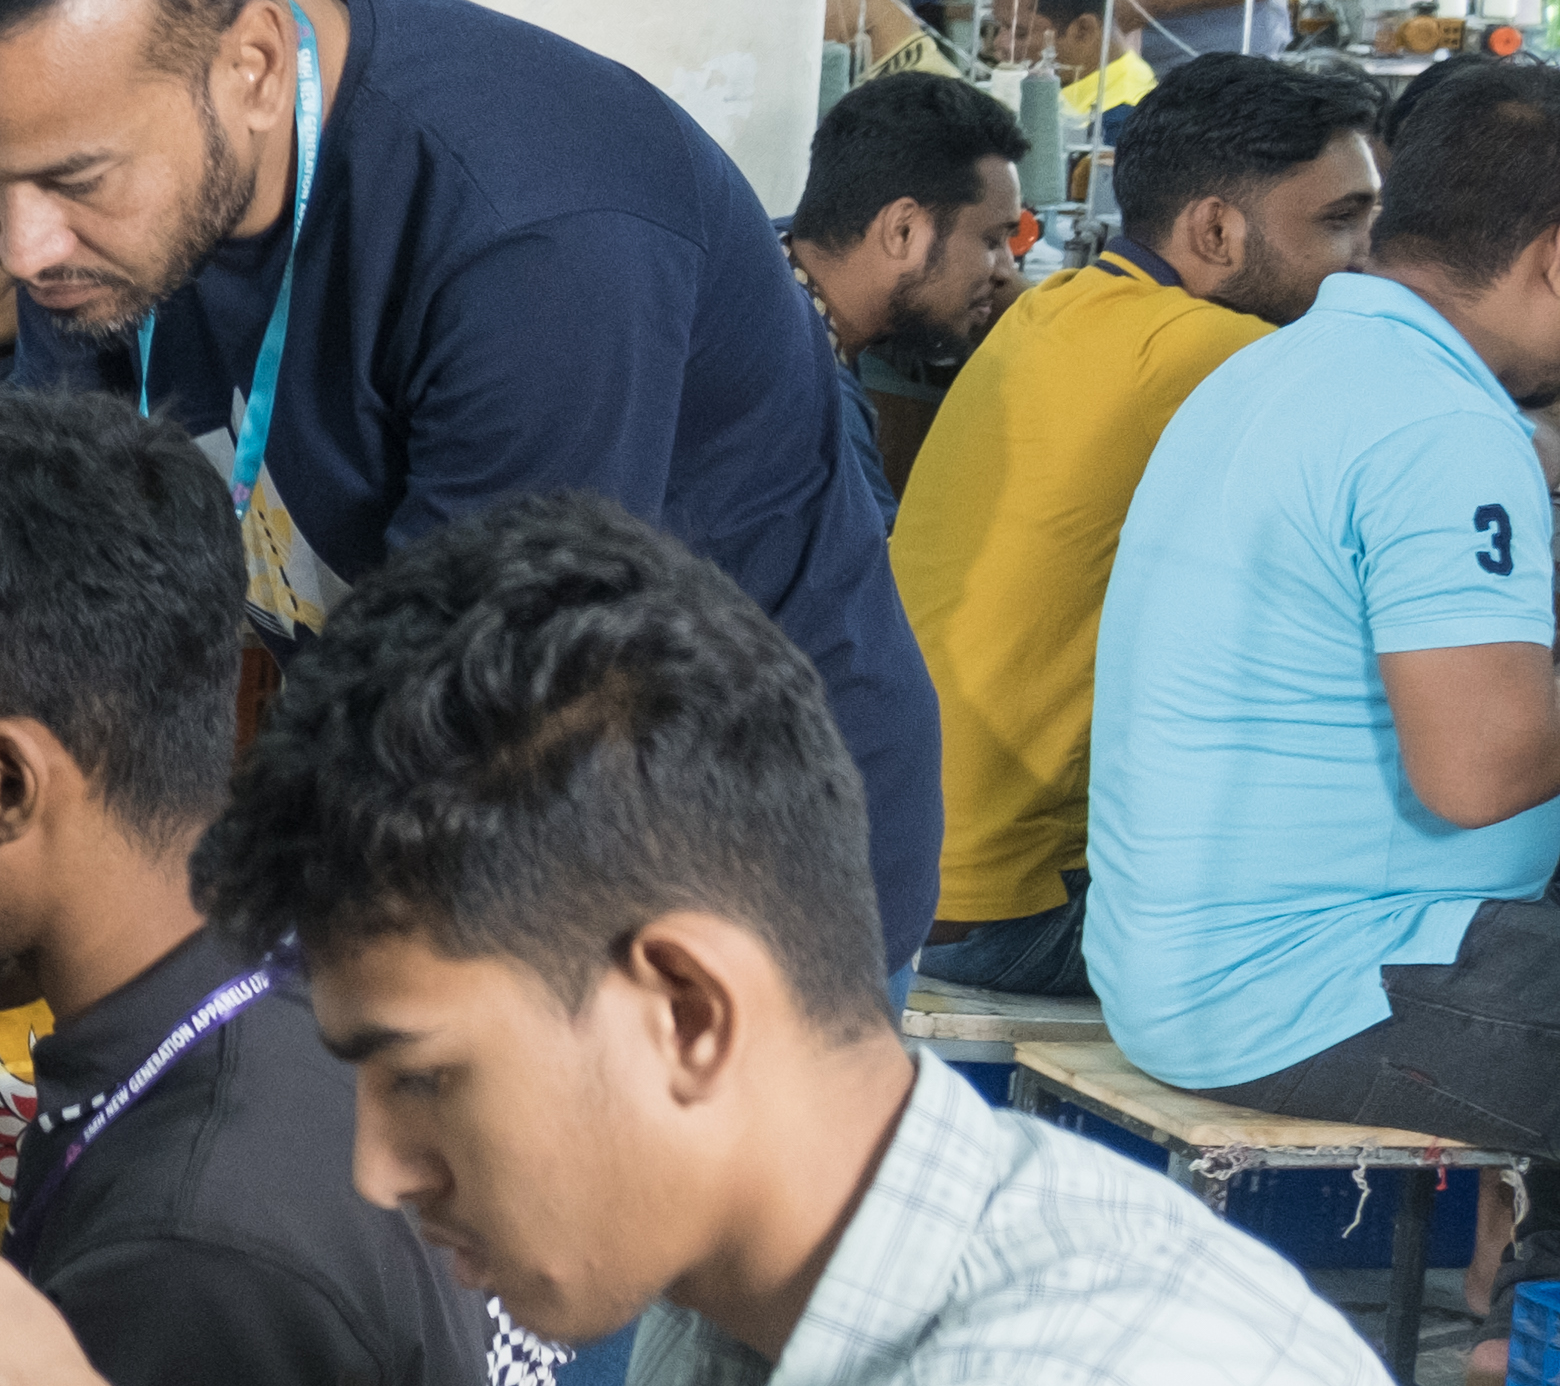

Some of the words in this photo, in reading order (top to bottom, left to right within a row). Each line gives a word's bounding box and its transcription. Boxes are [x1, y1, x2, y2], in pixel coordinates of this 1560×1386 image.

[297, 48, 313, 78] SMH
[299, 80, 317, 113] NEW
[301, 115, 318, 200] GENERATION
[1473, 503, 1515, 577] 3
[83, 1112, 106, 1143] SMH
[104, 1085, 130, 1118] NEW
[128, 1023, 196, 1094] GENERATION
[191, 980, 253, 1032] APPARELS
